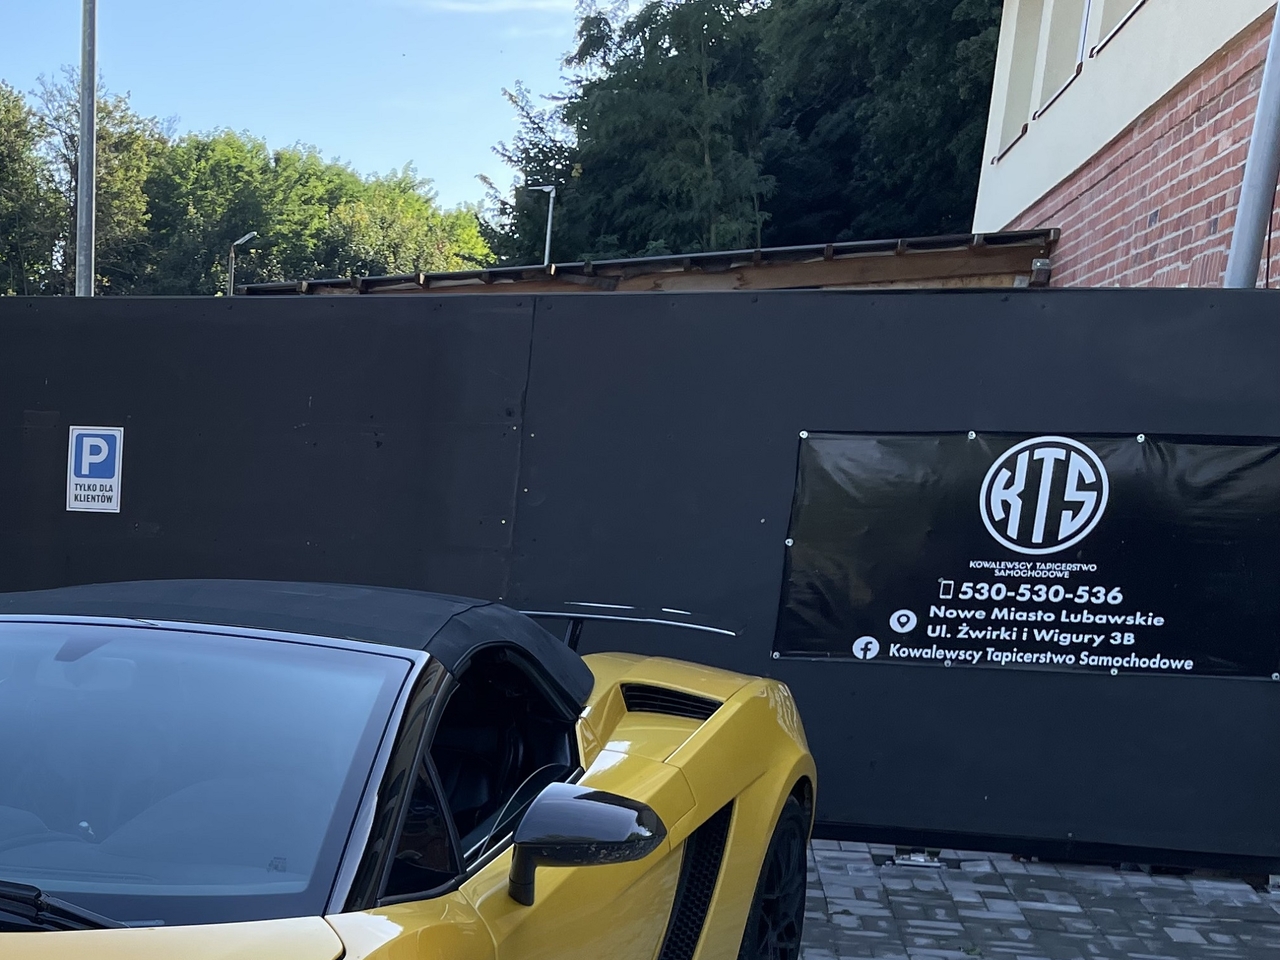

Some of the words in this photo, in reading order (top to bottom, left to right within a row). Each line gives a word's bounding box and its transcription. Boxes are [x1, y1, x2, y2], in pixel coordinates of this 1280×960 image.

[81, 436, 109, 475] P
[73, 492, 113, 504] KLIENTÓW
[74, 483, 97, 492] TYLKO
[99, 484, 113, 493] DLA
[990, 446, 1098, 544] KTS
[969, 560, 1033, 570] KOWALEWSCY
[1036, 562, 1097, 572] TAPICERSTWO
[994, 569, 1070, 578] SAMOCHODOWE
[958, 581, 1124, 605] 530-530-536
[929, 605, 987, 621] Nowe
[990, 606, 1056, 622] Miasto
[1060, 609, 1165, 627] Lubawskie
[926, 624, 952, 639] Ul.
[956, 622, 1018, 641] Żwirki
[1021, 627, 1028, 641] i
[1033, 629, 1106, 647] Wigury
[1109, 632, 1136, 645] 3B
[889, 643, 983, 663] Kowalewscy
[986, 647, 1076, 666] Tapicerstwo
[1079, 650, 1194, 671] Samochodowe
